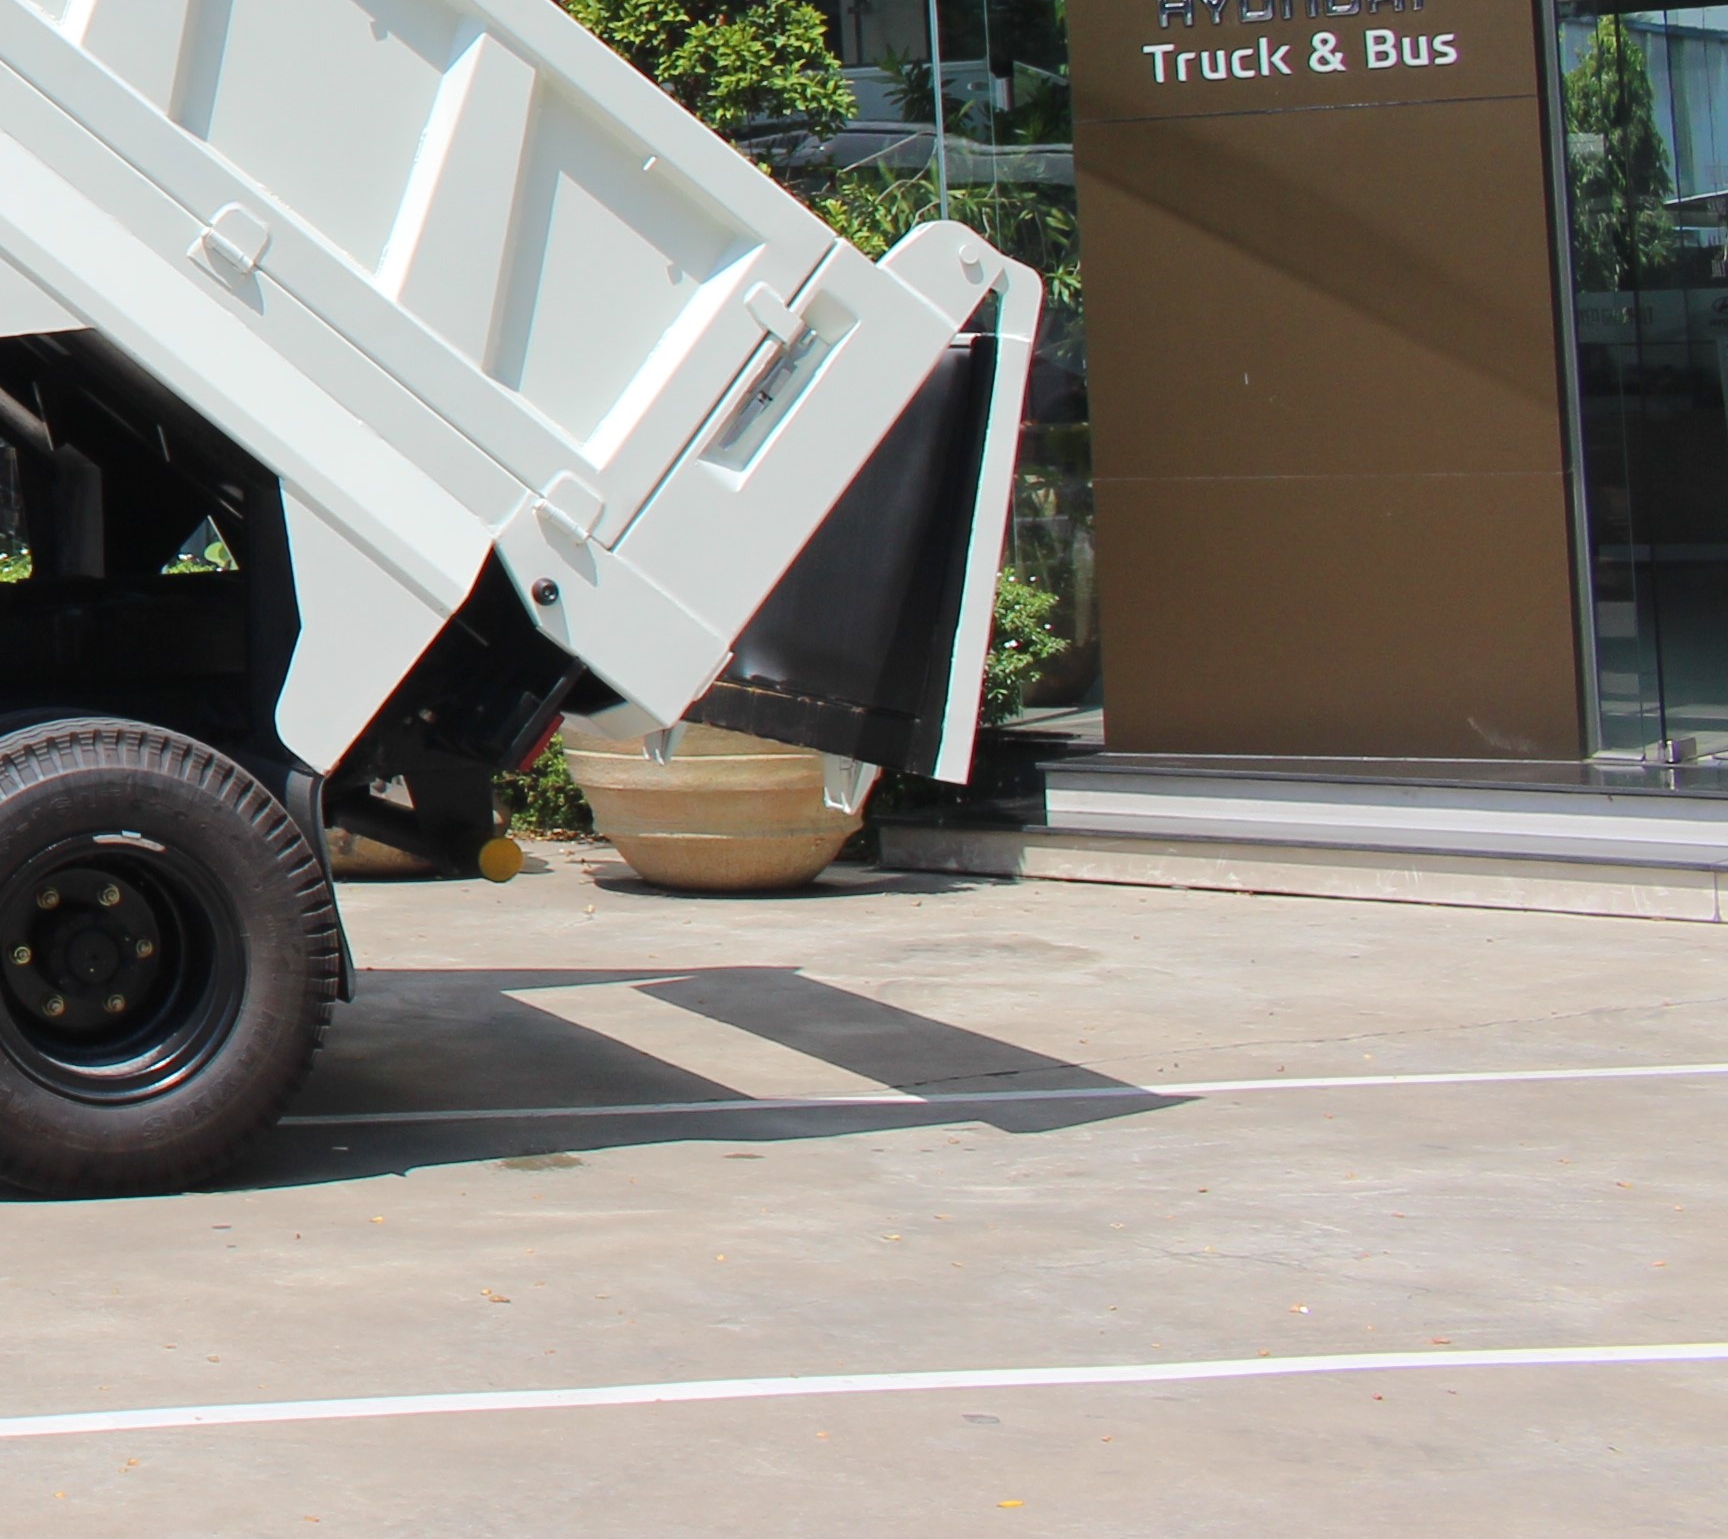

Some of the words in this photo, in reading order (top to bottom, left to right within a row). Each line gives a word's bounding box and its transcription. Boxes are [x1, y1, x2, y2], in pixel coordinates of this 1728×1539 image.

[1143, 35, 1293, 83] Truck
[1308, 31, 1346, 74] &
[1365, 27, 1458, 71] Bus
